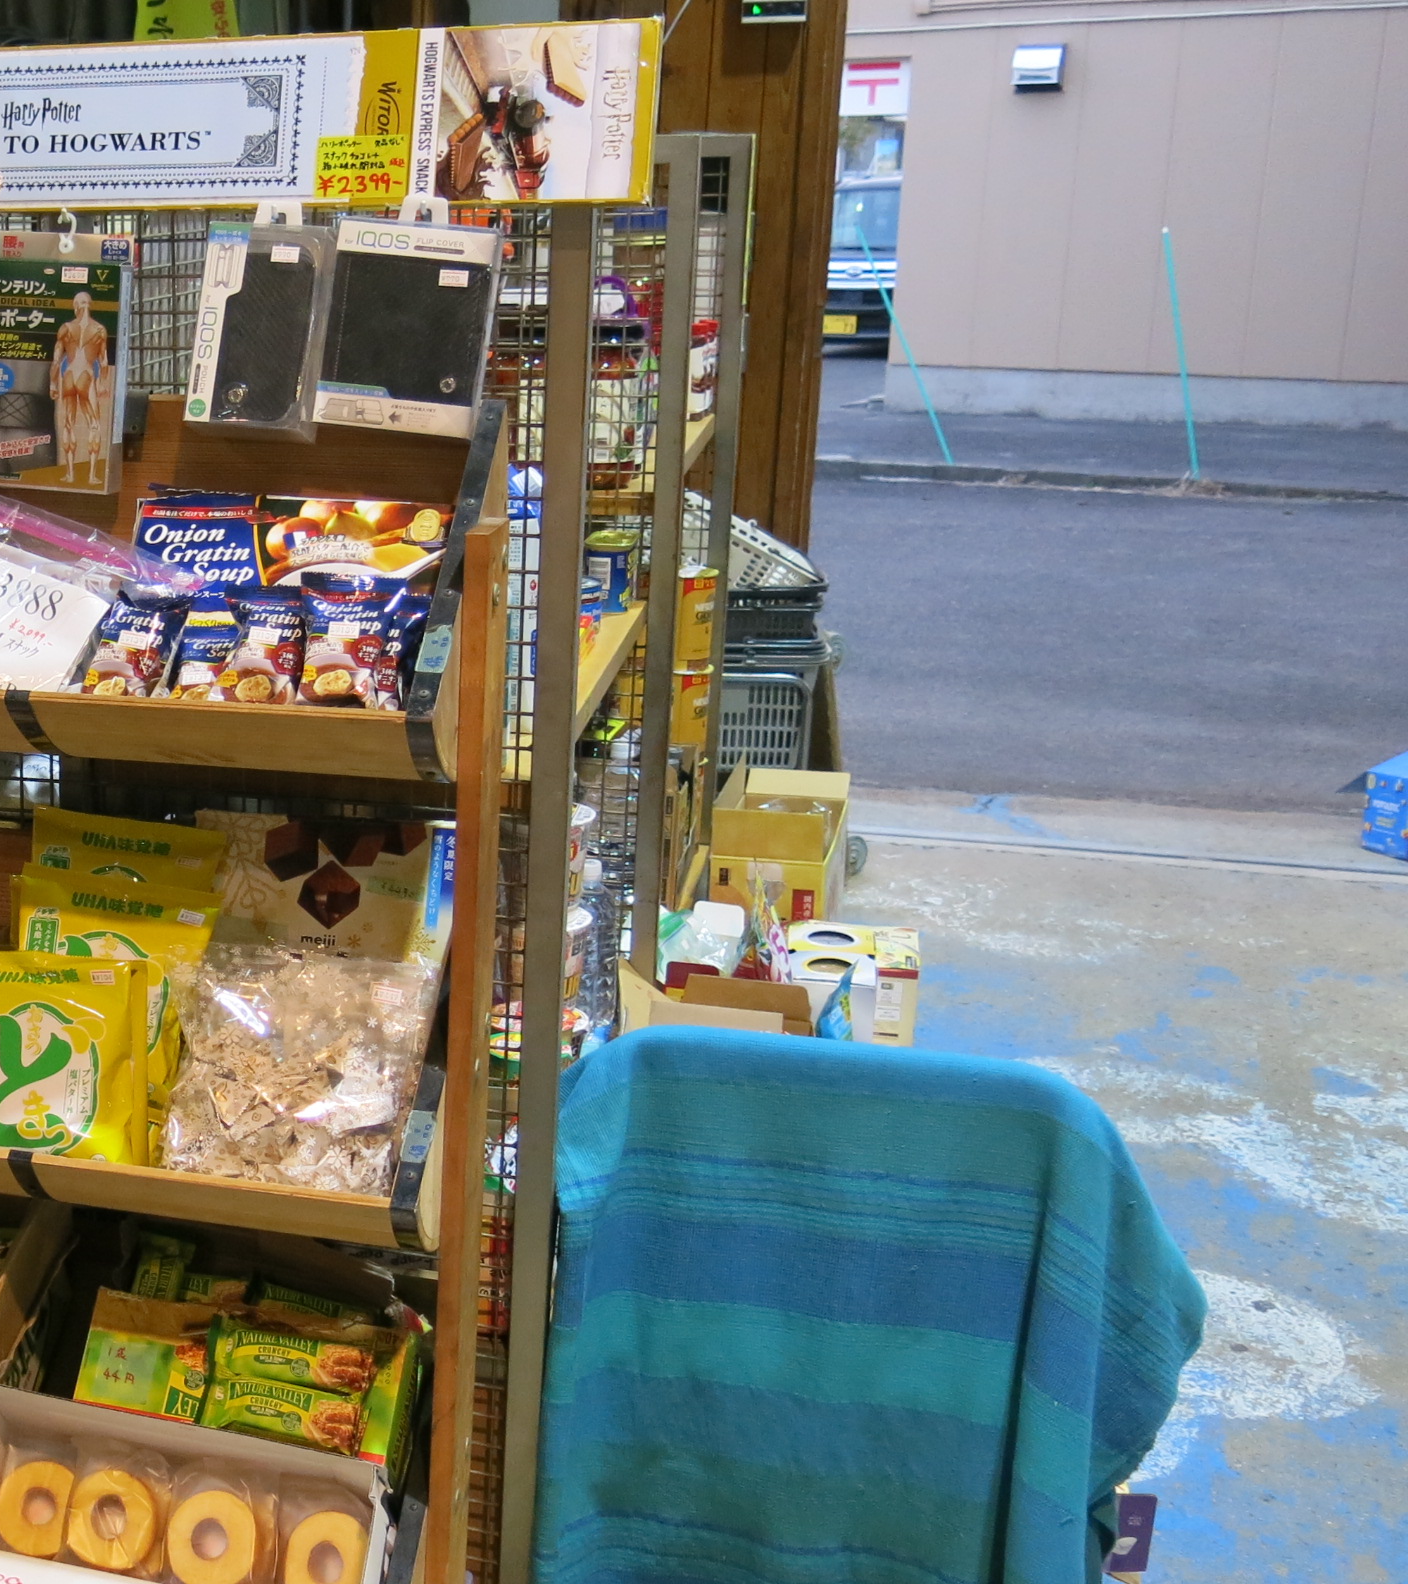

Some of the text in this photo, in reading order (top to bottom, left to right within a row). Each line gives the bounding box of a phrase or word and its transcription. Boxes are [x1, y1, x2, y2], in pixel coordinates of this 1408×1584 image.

[2, 97, 82, 131] Harry Potter
[414, 41, 439, 194] HOGWARTS SNACK
[601, 65, 632, 161] Harry Potter
[4, 135, 39, 155] TO
[103, 240, 128, 251] 大きめ
[356, 230, 410, 250] IQOS
[417, 237, 434, 245] FLIP
[436, 239, 465, 248] COVER
[32, 299, 56, 308] IDEA
[197, 306, 219, 360] IQOS
[144, 523, 226, 544] Onion
[161, 542, 251, 564] Gratin
[192, 562, 255, 586] Soup
[81, 831, 172, 857] UHA味覚糖
[70, 891, 165, 919] UHA味覚糖
[300, 935, 336, 948] meiji
[24, 1004, 45, 1056] おさつ
[79, 1068, 92, 1115] プレミアム
[238, 1331, 313, 1354] NATURE VALLEY
[258, 1346, 292, 1357] CRUNCHY
[101, 1367, 136, 1385] 44円
[234, 1382, 309, 1409] NATURE VALLEY
[250, 1396, 284, 1410] CRUNCHY
